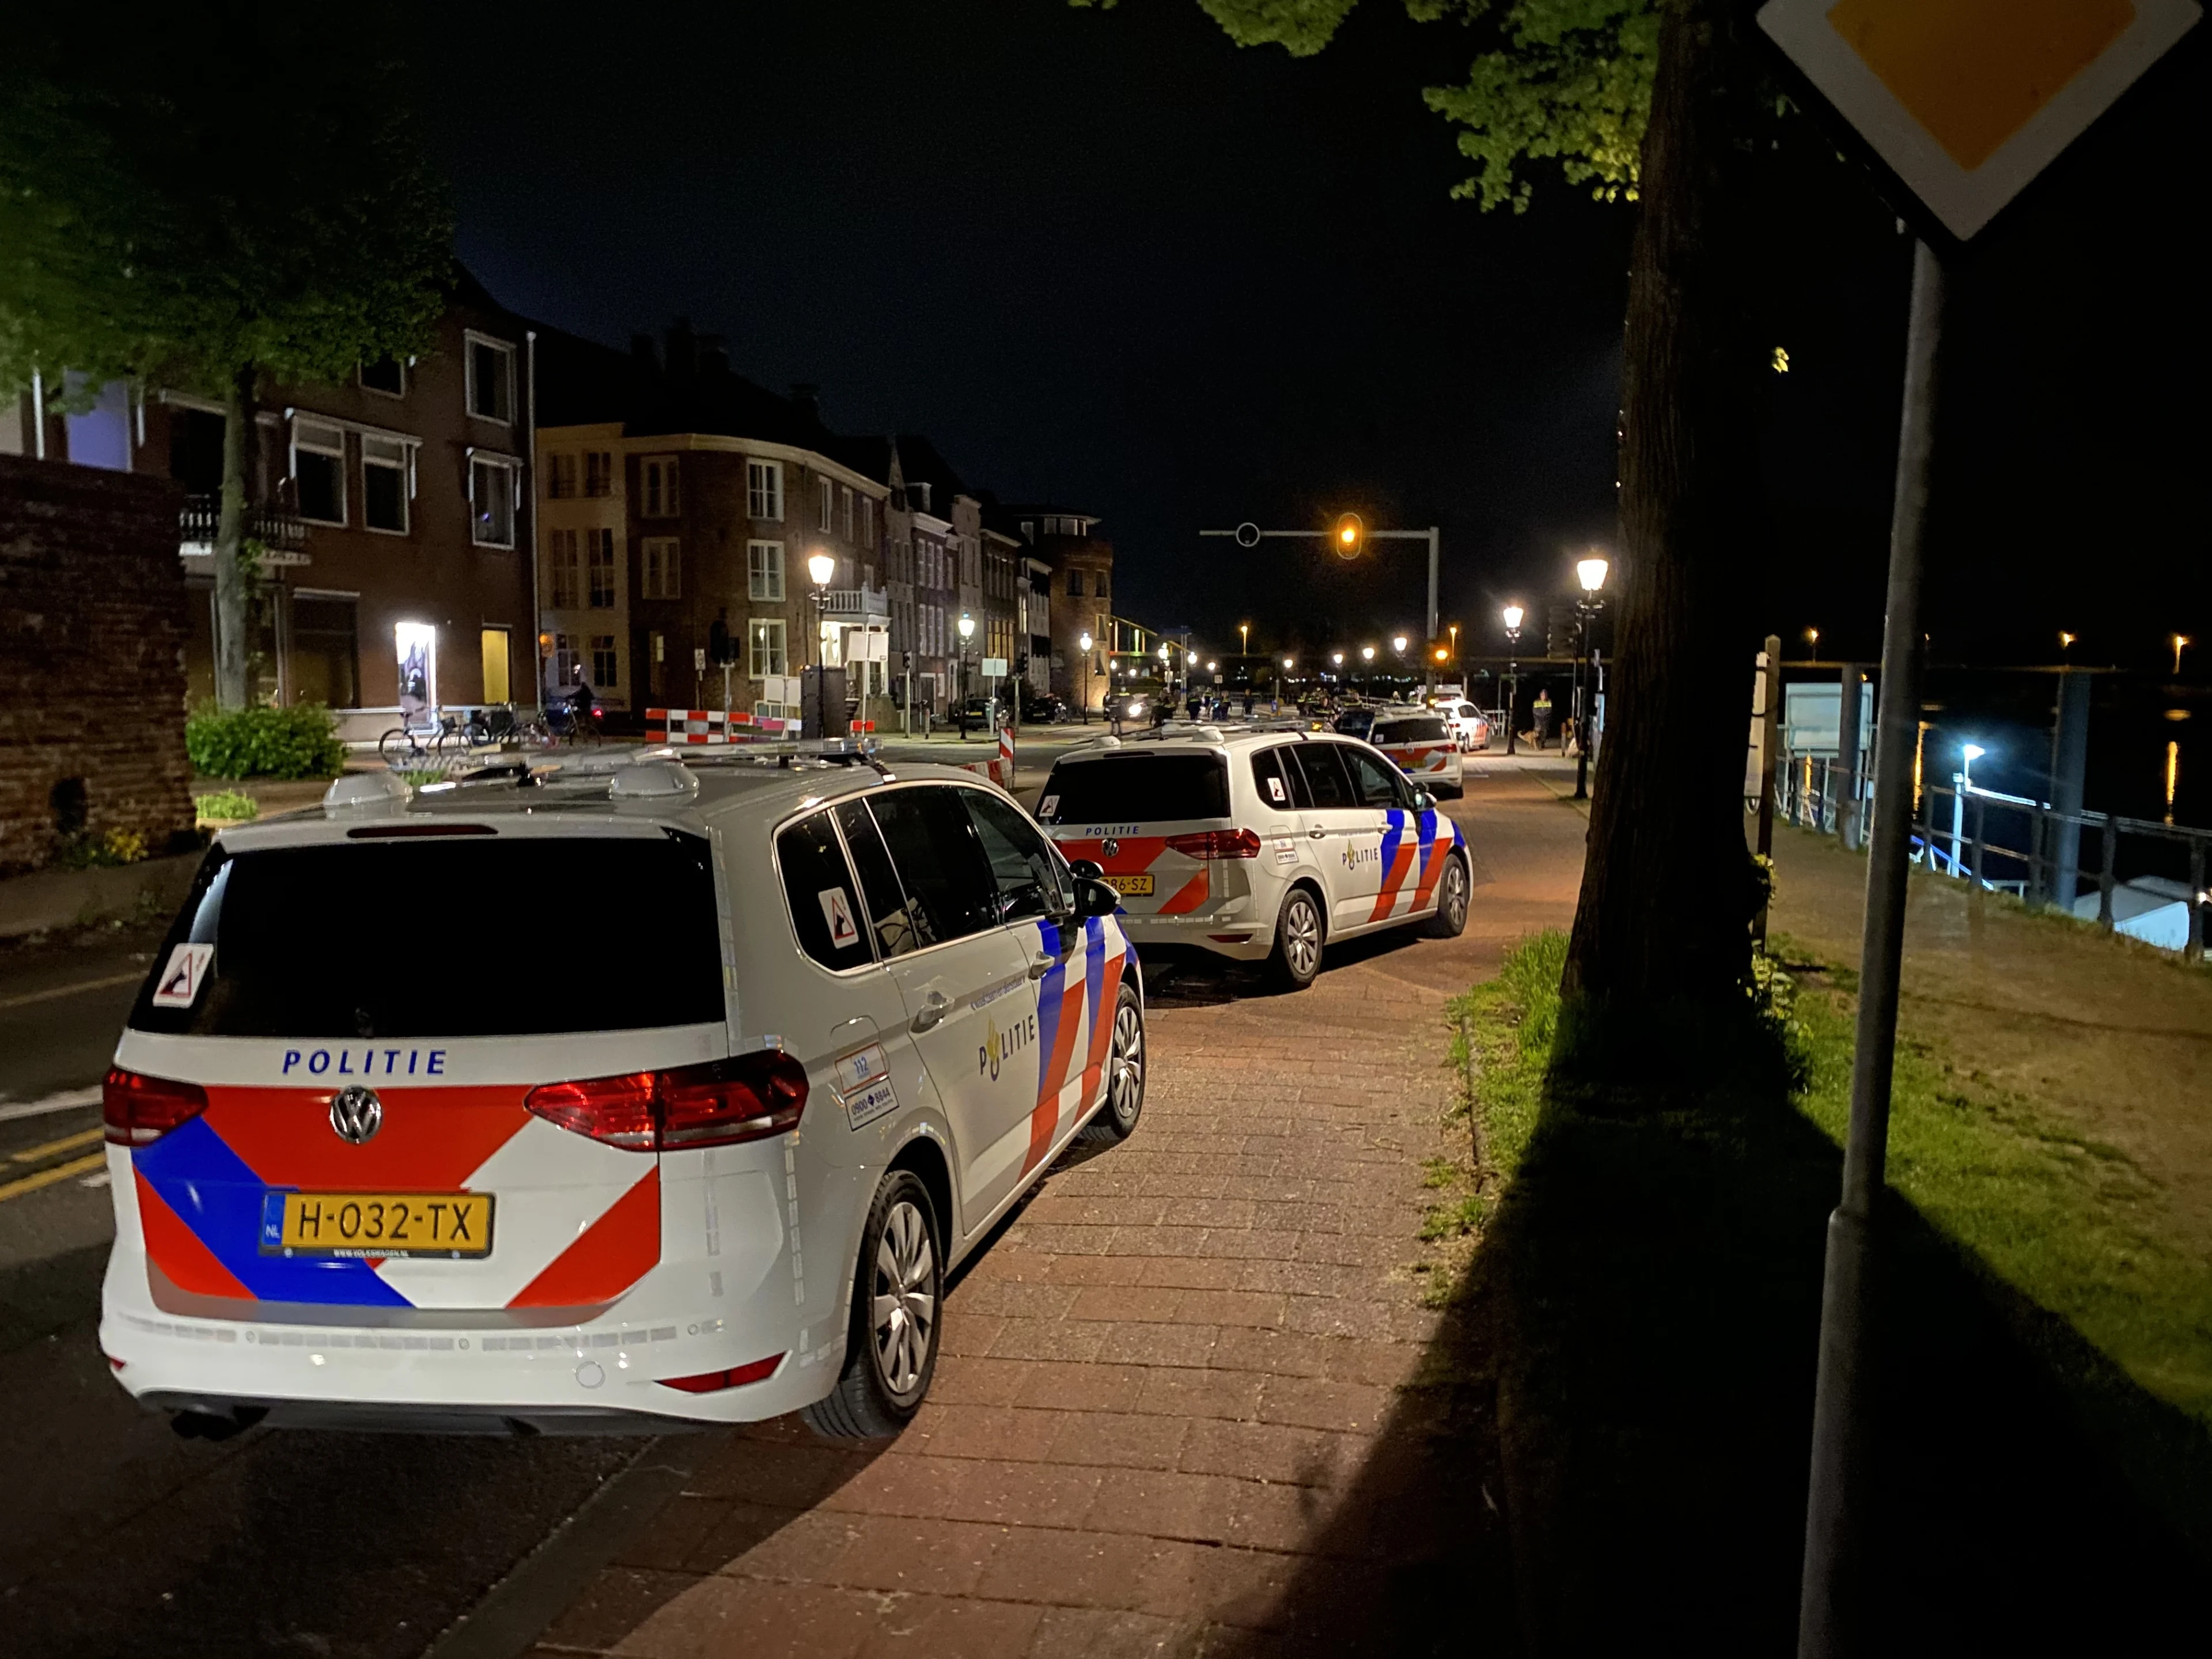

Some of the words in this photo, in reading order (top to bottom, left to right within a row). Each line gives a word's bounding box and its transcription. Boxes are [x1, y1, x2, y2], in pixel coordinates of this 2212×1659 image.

[1085, 826, 1139, 836] POLITIE
[1342, 848, 1378, 871] POLITIE
[979, 1014, 1035, 1082] POLITIE
[282, 1048, 446, 1075] POLITIE
[854, 1055, 869, 1074] 112
[851, 1099, 868, 1116] 0900
[298, 1200, 472, 1241] H-032-TX
[266, 1224, 281, 1238] NL
[333, 1248, 410, 1258] WWW.VOLKSWAGEN.NL
